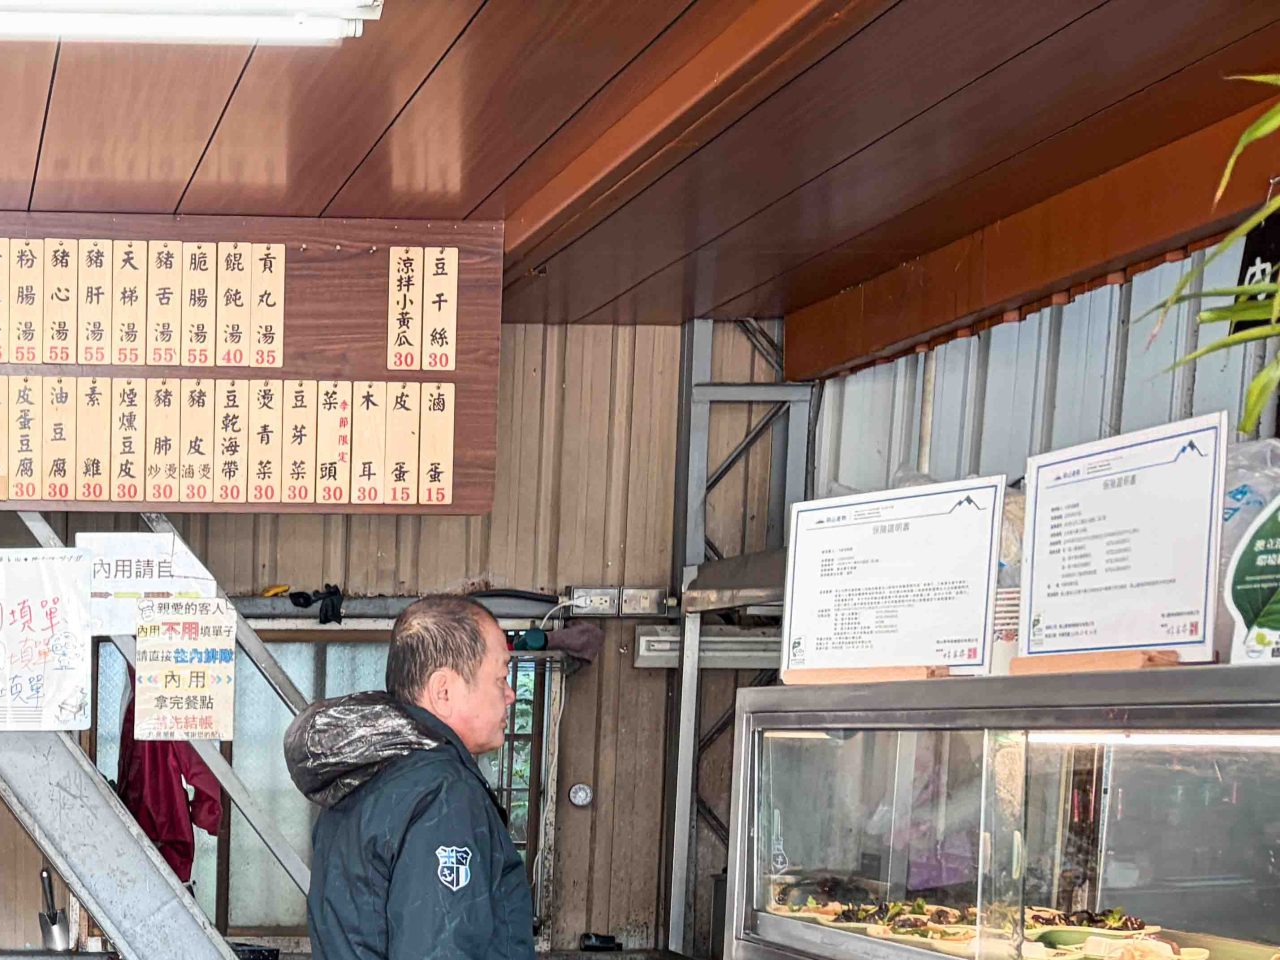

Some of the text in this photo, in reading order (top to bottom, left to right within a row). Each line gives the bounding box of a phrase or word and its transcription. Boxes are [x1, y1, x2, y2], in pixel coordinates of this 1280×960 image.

[15, 249, 37, 361] 粉腸湯 55
[49, 249, 70, 361] 豬心湯 55
[84, 249, 105, 361] 豬肝湯 55
[118, 250, 139, 362] 天梯湯 55
[153, 251, 174, 362] 豬舌湯 55
[188, 252, 209, 363] 脆腸湯 55
[222, 252, 244, 363] 餛飩湯 40
[255, 252, 277, 364] 貢丸湯 35
[393, 256, 415, 367] 涼拌小黃瓜 30
[428, 258, 449, 367] 豆干絲 30
[15, 385, 36, 497] 皮蛋豆腐 30
[48, 386, 69, 498] 油豆腐 30
[82, 386, 103, 498] 素雞 30
[117, 388, 138, 498] 煙燻豆皮 30
[154, 388, 173, 456] 豬肺
[187, 388, 207, 456] 豬皮
[220, 389, 241, 499] 豆乾海帶 30
[254, 389, 275, 500] 燙青菜 30
[287, 390, 308, 500] 豆芽菜 30
[320, 390, 349, 500] 菜頭 季節限定 30
[357, 391, 379, 501] 木耳 30
[391, 392, 412, 501] 皮蛋 15
[426, 393, 446, 502] 滷蛋 15
[152, 484, 173, 498] 30
[186, 484, 207, 499] 30
[157, 602, 224, 616] 親愛的客人
[154, 695, 214, 710] 拿完餐點
